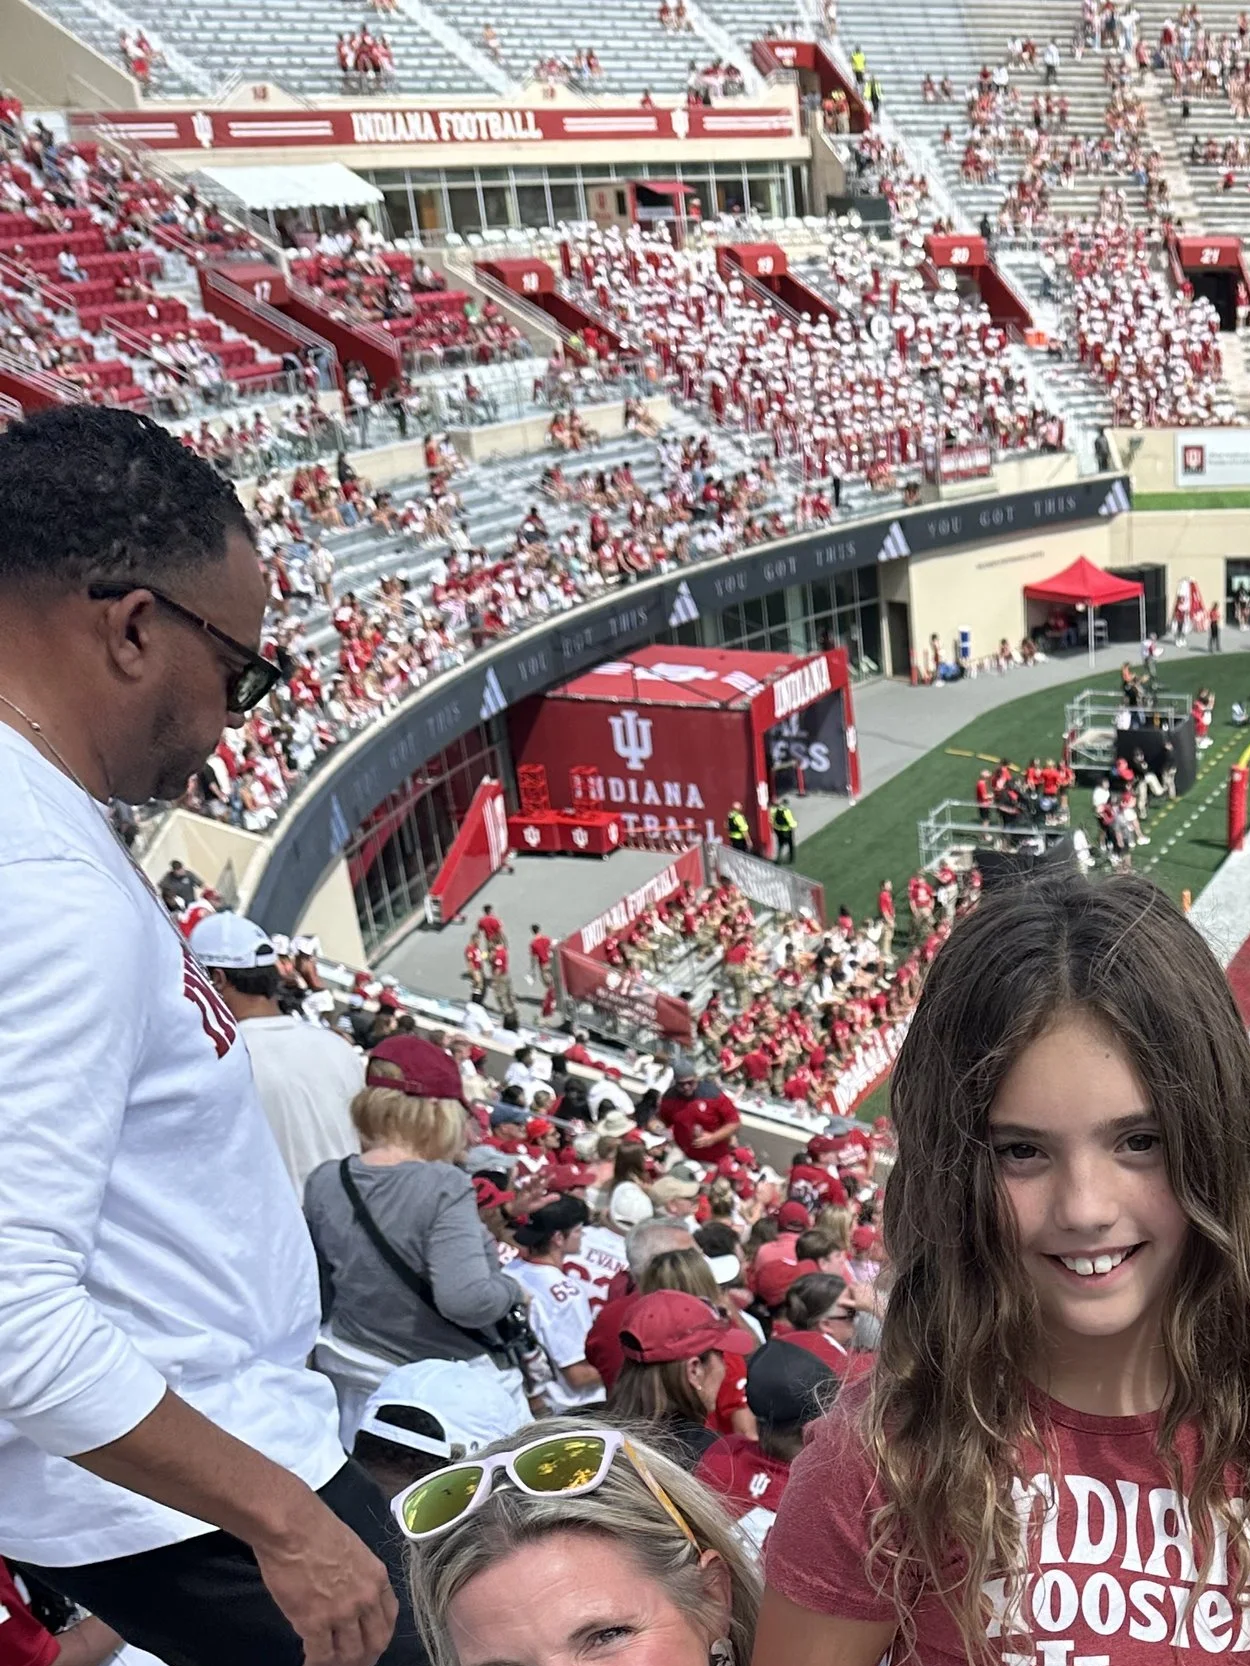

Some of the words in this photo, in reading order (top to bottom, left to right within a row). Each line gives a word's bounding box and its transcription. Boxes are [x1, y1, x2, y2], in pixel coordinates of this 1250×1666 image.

[350, 111, 436, 142] INDIANA
[439, 110, 544, 141] FOOTBALL
[928, 515, 962, 540] YOU
[979, 505, 1015, 528] GOT
[1033, 496, 1077, 518] THIS
[714, 574, 749, 598] YOU
[763, 556, 799, 582] GOT
[814, 540, 857, 567] THIS
[773, 655, 832, 719] INDIANA
[573, 774, 706, 810] INDIANA
